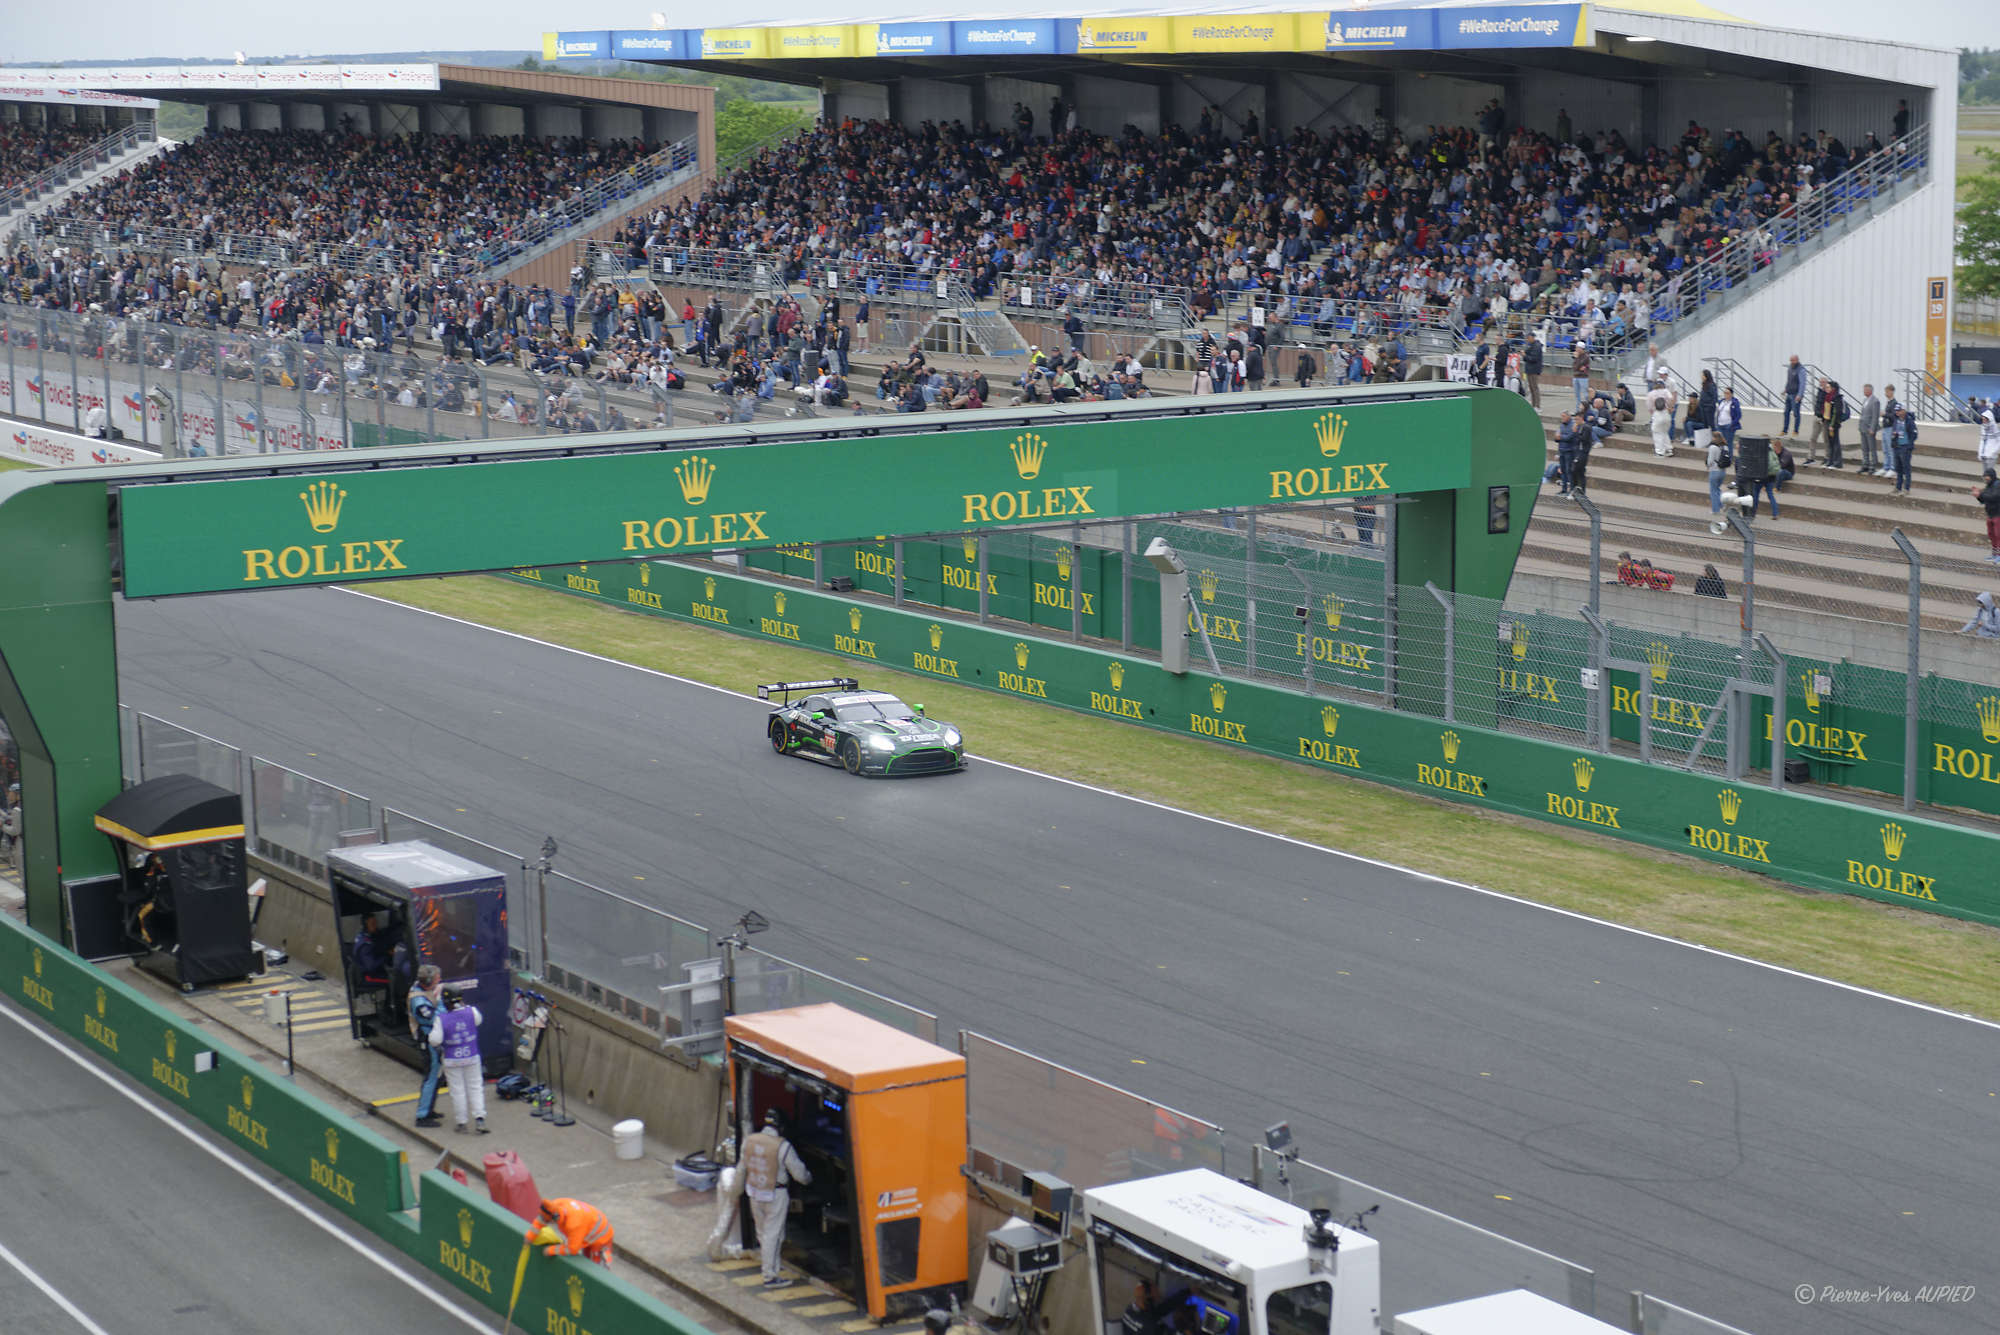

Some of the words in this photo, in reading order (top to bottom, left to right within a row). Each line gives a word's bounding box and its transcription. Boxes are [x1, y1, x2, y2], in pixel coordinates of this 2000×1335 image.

[890, 36, 933, 46] MICHELIN
[1096, 31, 1148, 42] MICHELIN
[1192, 25, 1275, 41] #WeRaceForChange
[1346, 26, 1408, 39] MICHELIN
[1459, 18, 1560, 35] #WeRaceForChange
[1270, 464, 1389, 498] ROLEX
[963, 486, 1094, 522] ROLEX
[623, 512, 768, 550] ROLEX
[243, 539, 406, 581] ROLEX
[568, 574, 600, 594] ROLEX
[628, 588, 662, 608] ROLEX
[692, 602, 728, 624] ROLEX
[762, 618, 800, 640] ROLEX
[835, 634, 876, 658] ROLEX
[914, 652, 958, 677] ROLEX
[999, 672, 1048, 698] ROLEX
[1091, 692, 1143, 719] ROLEX
[1191, 714, 1247, 743] ROLEX
[1299, 738, 1360, 768] ROLEX
[1417, 764, 1485, 796] ROLEX
[1547, 792, 1621, 828] ROLEX
[1690, 824, 1771, 863] ROLEX
[1848, 860, 1936, 901] ROLEX
[24, 976, 54, 1010] ROLEX
[86, 1015, 118, 1052] ROLEX
[152, 1059, 189, 1097] ROLEX
[228, 1106, 267, 1148] ROLEX
[312, 1158, 355, 1204] ROLEX
[440, 1240, 492, 1293] ROLEX
